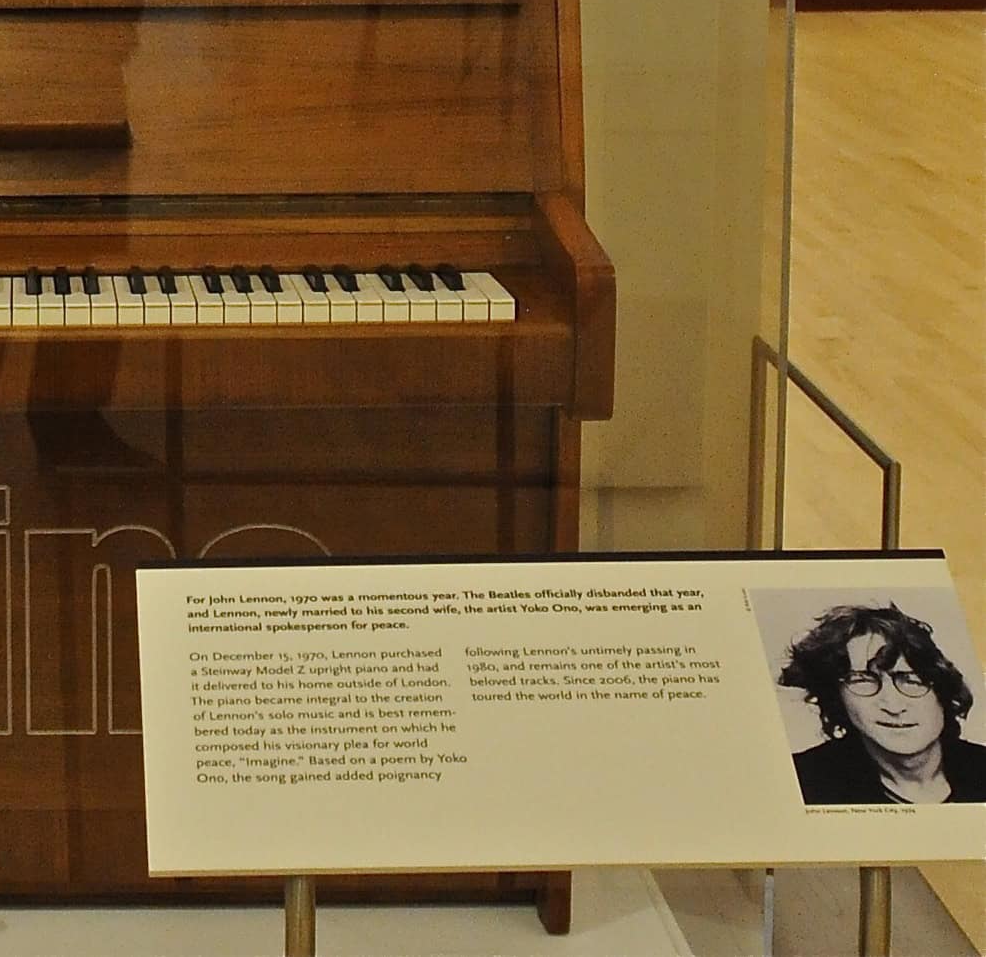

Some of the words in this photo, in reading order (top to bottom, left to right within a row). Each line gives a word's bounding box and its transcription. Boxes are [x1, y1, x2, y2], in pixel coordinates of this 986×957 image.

[185, 595, 206, 604] For
[208, 594, 235, 605] John
[238, 593, 287, 604] Lennon,
[289, 595, 318, 605] 1970
[320, 594, 344, 602] was
[357, 592, 429, 601] momentous
[431, 592, 459, 603] year.
[461, 589, 485, 599] The
[487, 588, 531, 599] Beatles
[533, 588, 583, 601] officially
[585, 587, 646, 598] disbanded
[649, 587, 674, 597] that
[675, 589, 704, 599] year,
[186, 608, 209, 618] and
[212, 608, 261, 619] Lennon,
[264, 607, 298, 619] newly
[301, 605, 347, 616] married
[350, 607, 363, 616] to
[365, 605, 384, 615] his
[386, 604, 429, 615] second
[431, 604, 461, 615] wife,
[463, 603, 484, 614] the
[486, 603, 518, 613] artist
[519, 603, 549, 613] Yoko
[551, 603, 582, 614] Ono,
[584, 604, 609, 612] was
[611, 601, 668, 614] emerging
[670, 603, 684, 611] as
[686, 603, 702, 611] an
[187, 621, 262, 633] international
[265, 620, 348, 634] spokesperson
[350, 619, 368, 630] for
[371, 622, 410, 632] peace.
[188, 651, 208, 661] On
[212, 650, 274, 661] December
[277, 652, 293, 662] 15,
[296, 652, 328, 662] 1970,
[331, 649, 376, 659] Lennon
[380, 647, 442, 660] purchased
[464, 646, 520, 659] following
[522, 646, 578, 656] Lennon's
[580, 644, 632, 657] untimely
[635, 646, 682, 657] passing
[684, 645, 696, 653] in
[200, 665, 253, 678] Steinway
[255, 665, 294, 675] Model
[296, 664, 306, 674] Z
[308, 663, 352, 677] upright
[355, 665, 388, 676] piano
[391, 662, 414, 673] and
[416, 662, 439, 672] had
[466, 661, 499, 673] 1980,
[502, 660, 525, 671] and
[528, 661, 577, 671] remains
[579, 662, 603, 670] one
[606, 659, 619, 669] of
[621, 659, 641, 669] the
[644, 659, 686, 669] artist's
[688, 660, 721, 669] most
[191, 682, 200, 691] it
[202, 680, 257, 691] delivered
[260, 681, 274, 690] to
[276, 679, 295, 689] his
[298, 679, 333, 689] home
[336, 678, 382, 688] outside
[384, 677, 398, 687] of
[400, 677, 451, 687] London.
[469, 675, 516, 686] beloved
[519, 675, 560, 685] tracks.
[562, 675, 596, 685] Since
[598, 674, 636, 685] 2006,
[637, 674, 658, 684] the
[661, 674, 695, 686] piano
[696, 673, 720, 683] has
[189, 695, 214, 706] The
[216, 697, 251, 707] piano
[254, 694, 303, 705] became
[306, 693, 351, 706] integral
[354, 694, 368, 703] to
[370, 692, 390, 703] the
[393, 693, 443, 703] creation
[471, 690, 512, 701] toured
[515, 690, 535, 700] the
[537, 690, 572, 700] world
[576, 690, 588, 699] in
[590, 689, 610, 699] the
[614, 691, 648, 699] name
[651, 688, 664, 699] of
[667, 691, 706, 701] peace.
[190, 710, 206, 721] of
[209, 710, 264, 721] Lennon's
[267, 709, 294, 719] solo
[297, 710, 334, 719] music
[337, 708, 361, 718] and
[364, 709, 374, 718] is
[377, 707, 404, 718] best
[407, 709, 457, 717] remem-
[193, 725, 229, 736] bered
[232, 725, 266, 738] today
[269, 727, 284, 735] as
[286, 724, 307, 735] the
[310, 724, 378, 734] instrument
[381, 725, 398, 733] on
[400, 722, 438, 733] which
[440, 721, 457, 732] he
[194, 740, 259, 754] composed
[262, 739, 281, 750] his
[284, 741, 340, 752] visionary
[343, 738, 369, 751] plea
[372, 738, 390, 748] for
[392, 737, 428, 748] world
[196, 759, 236, 770] peace,
[308, 754, 346, 765] Based
[380, 756, 416, 766] poem
[418, 753, 434, 766] by
[436, 752, 469, 763] Yoko
[196, 772, 228, 784] Ono,
[231, 772, 252, 782] the
[255, 774, 286, 784] song
[289, 770, 331, 784] gained
[335, 770, 373, 781] added
[377, 770, 441, 783] poignancy
